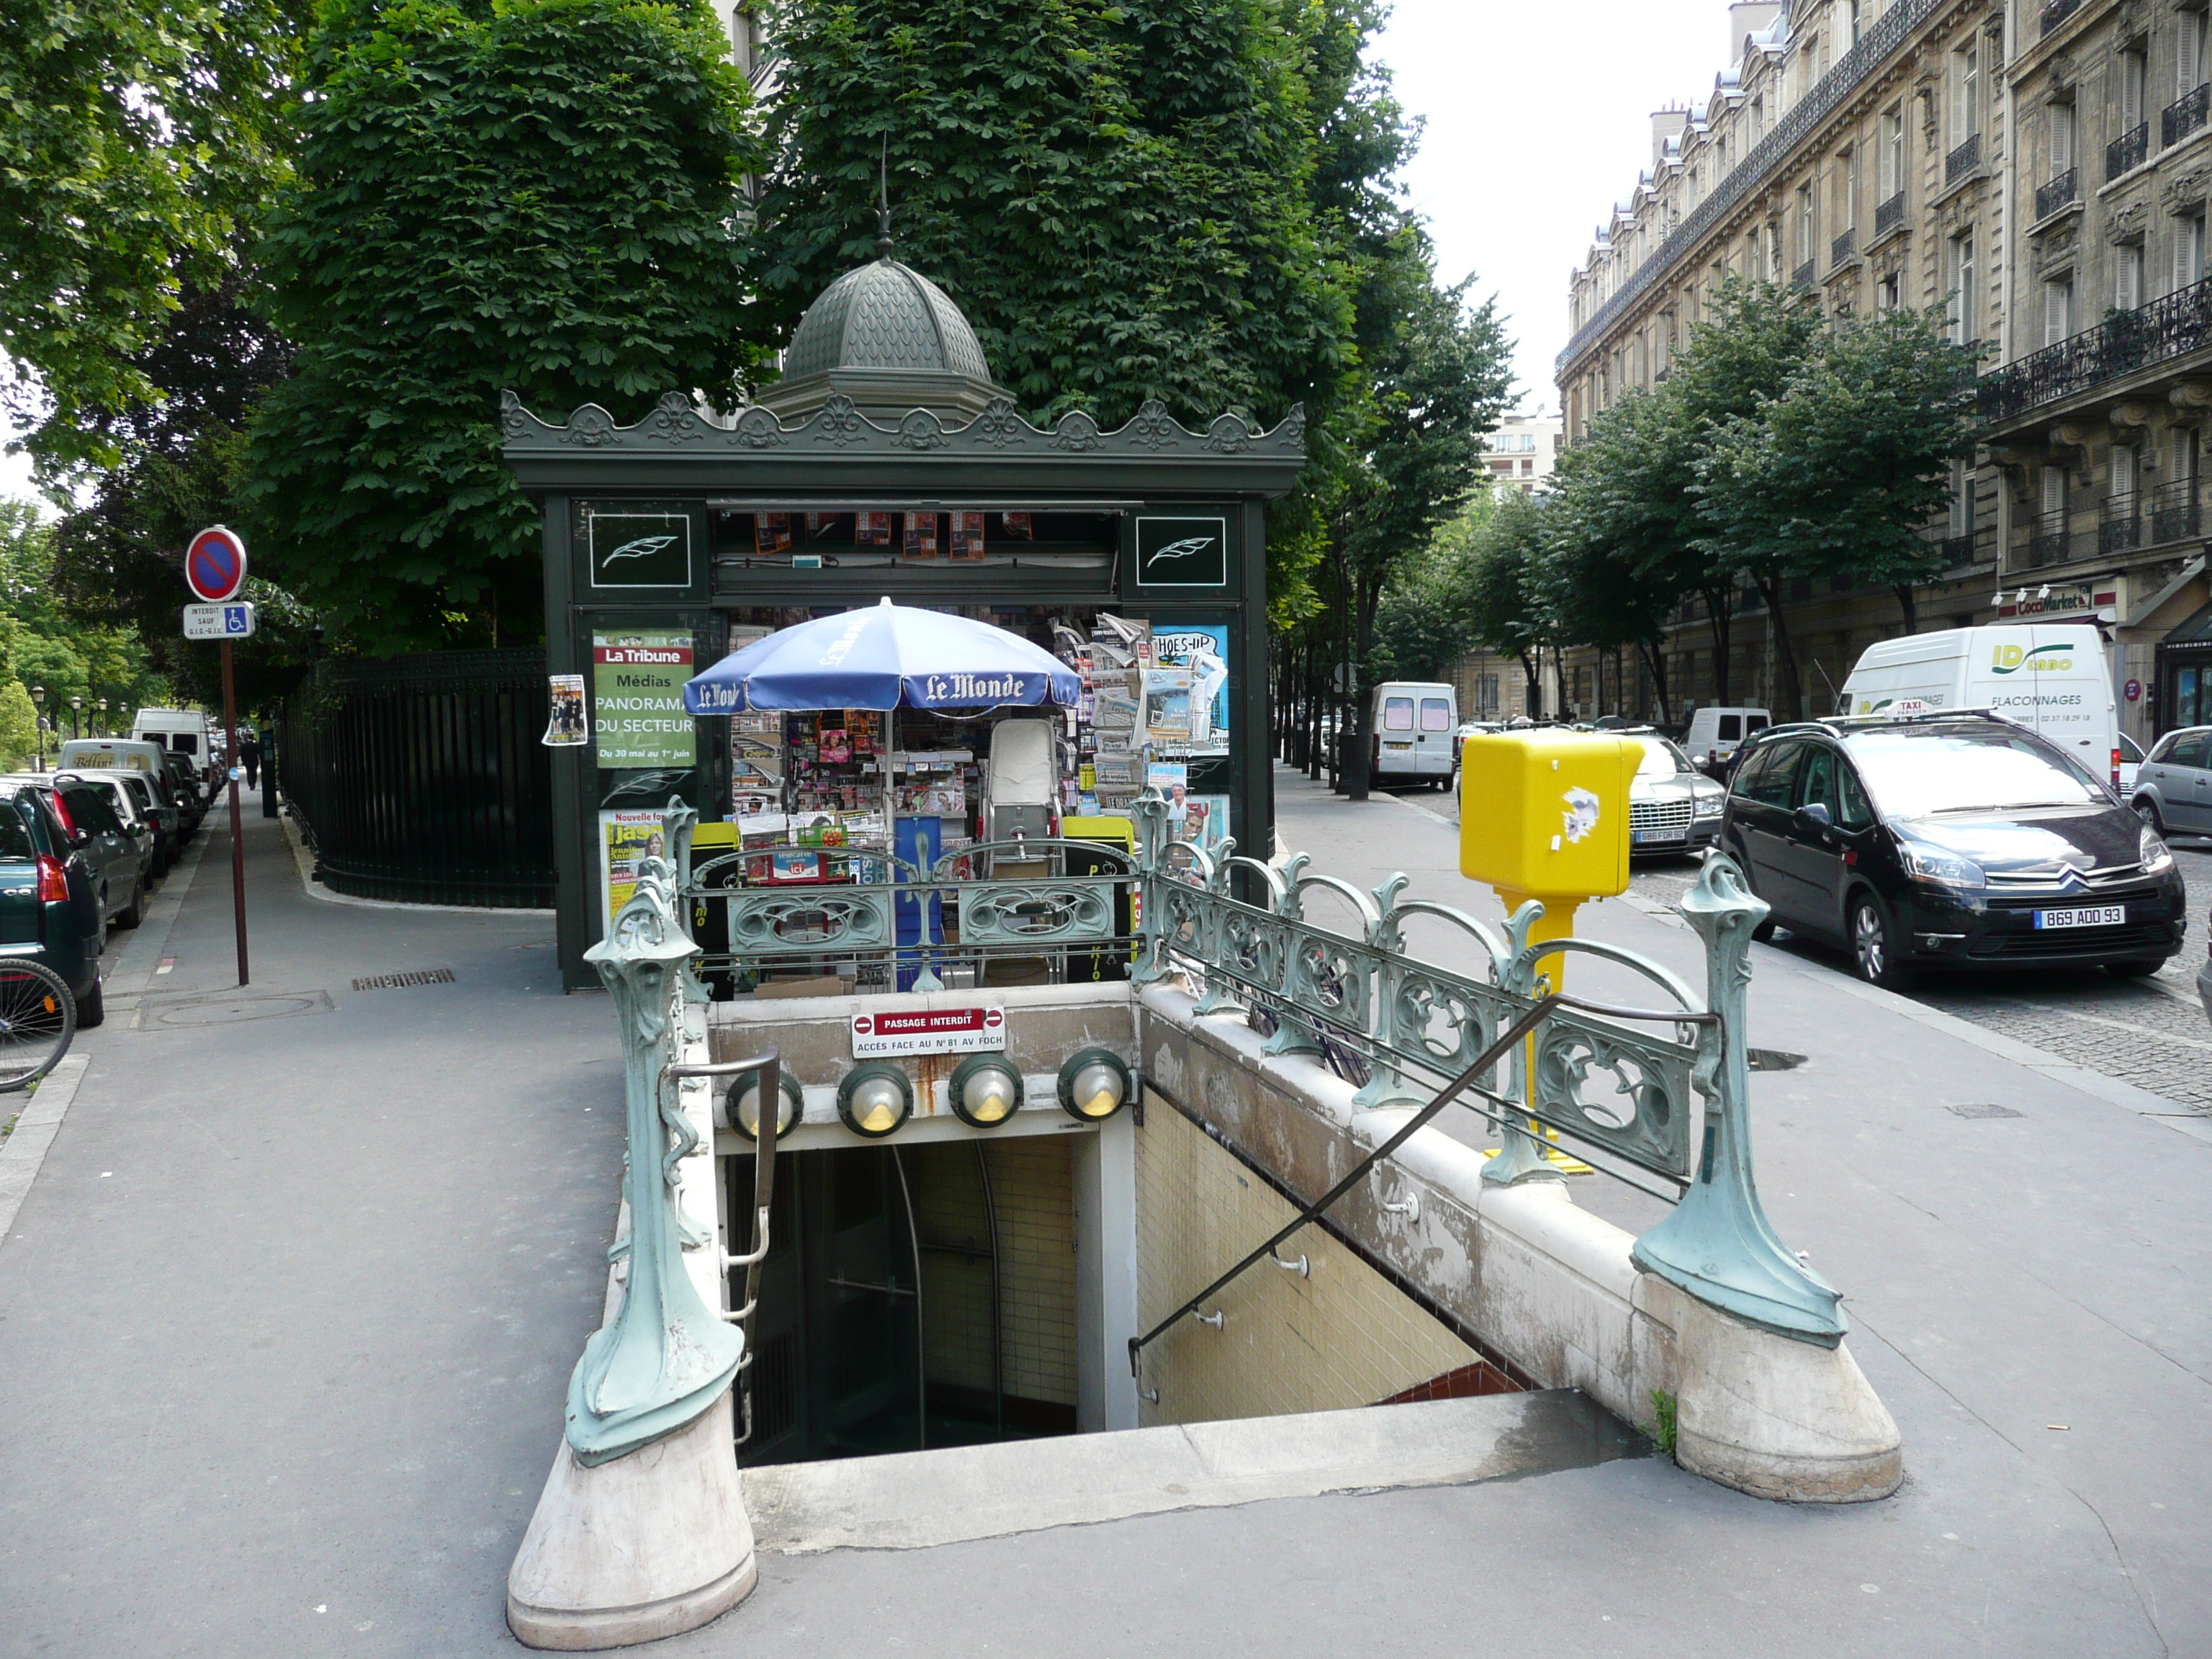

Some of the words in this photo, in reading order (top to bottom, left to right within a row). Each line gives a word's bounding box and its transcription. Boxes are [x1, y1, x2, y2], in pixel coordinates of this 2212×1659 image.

[2018, 593, 2077, 615] CocciMarket
[1153, 637, 1210, 653] HOES-UP
[606, 649, 624, 662] La
[625, 649, 680, 662] Tribune
[1992, 644, 2023, 667] ID
[2027, 659, 2072, 670] LABO
[616, 675, 671, 687] Médias
[926, 675, 948, 701] Le
[950, 673, 1025, 698] Monde
[696, 685, 711, 708] Le
[1992, 695, 2082, 706] FLACONNAGES
[1900, 701, 1921, 710] TAXI
[595, 719, 618, 732] DU
[623, 719, 693, 732] SECTEUR
[73, 753, 113, 768] Bellini
[673, 750, 690, 759] juin
[616, 813, 651, 822] Nouvelle
[791, 865, 802, 873] ici
[2047, 912, 2072, 926] 869
[2077, 909, 2100, 925] ADD
[2105, 908, 2121, 922] 93
[884, 1017, 926, 1028] PASSAGE
[930, 1016, 972, 1026] INTERDIT
[858, 1041, 887, 1051] ACCÈS
[892, 1040, 914, 1050] FACE
[919, 1040, 931, 1048] AU
[948, 1038, 958, 1047] 81
[962, 1038, 974, 1046] AV
[979, 1035, 1002, 1045] FOCH
